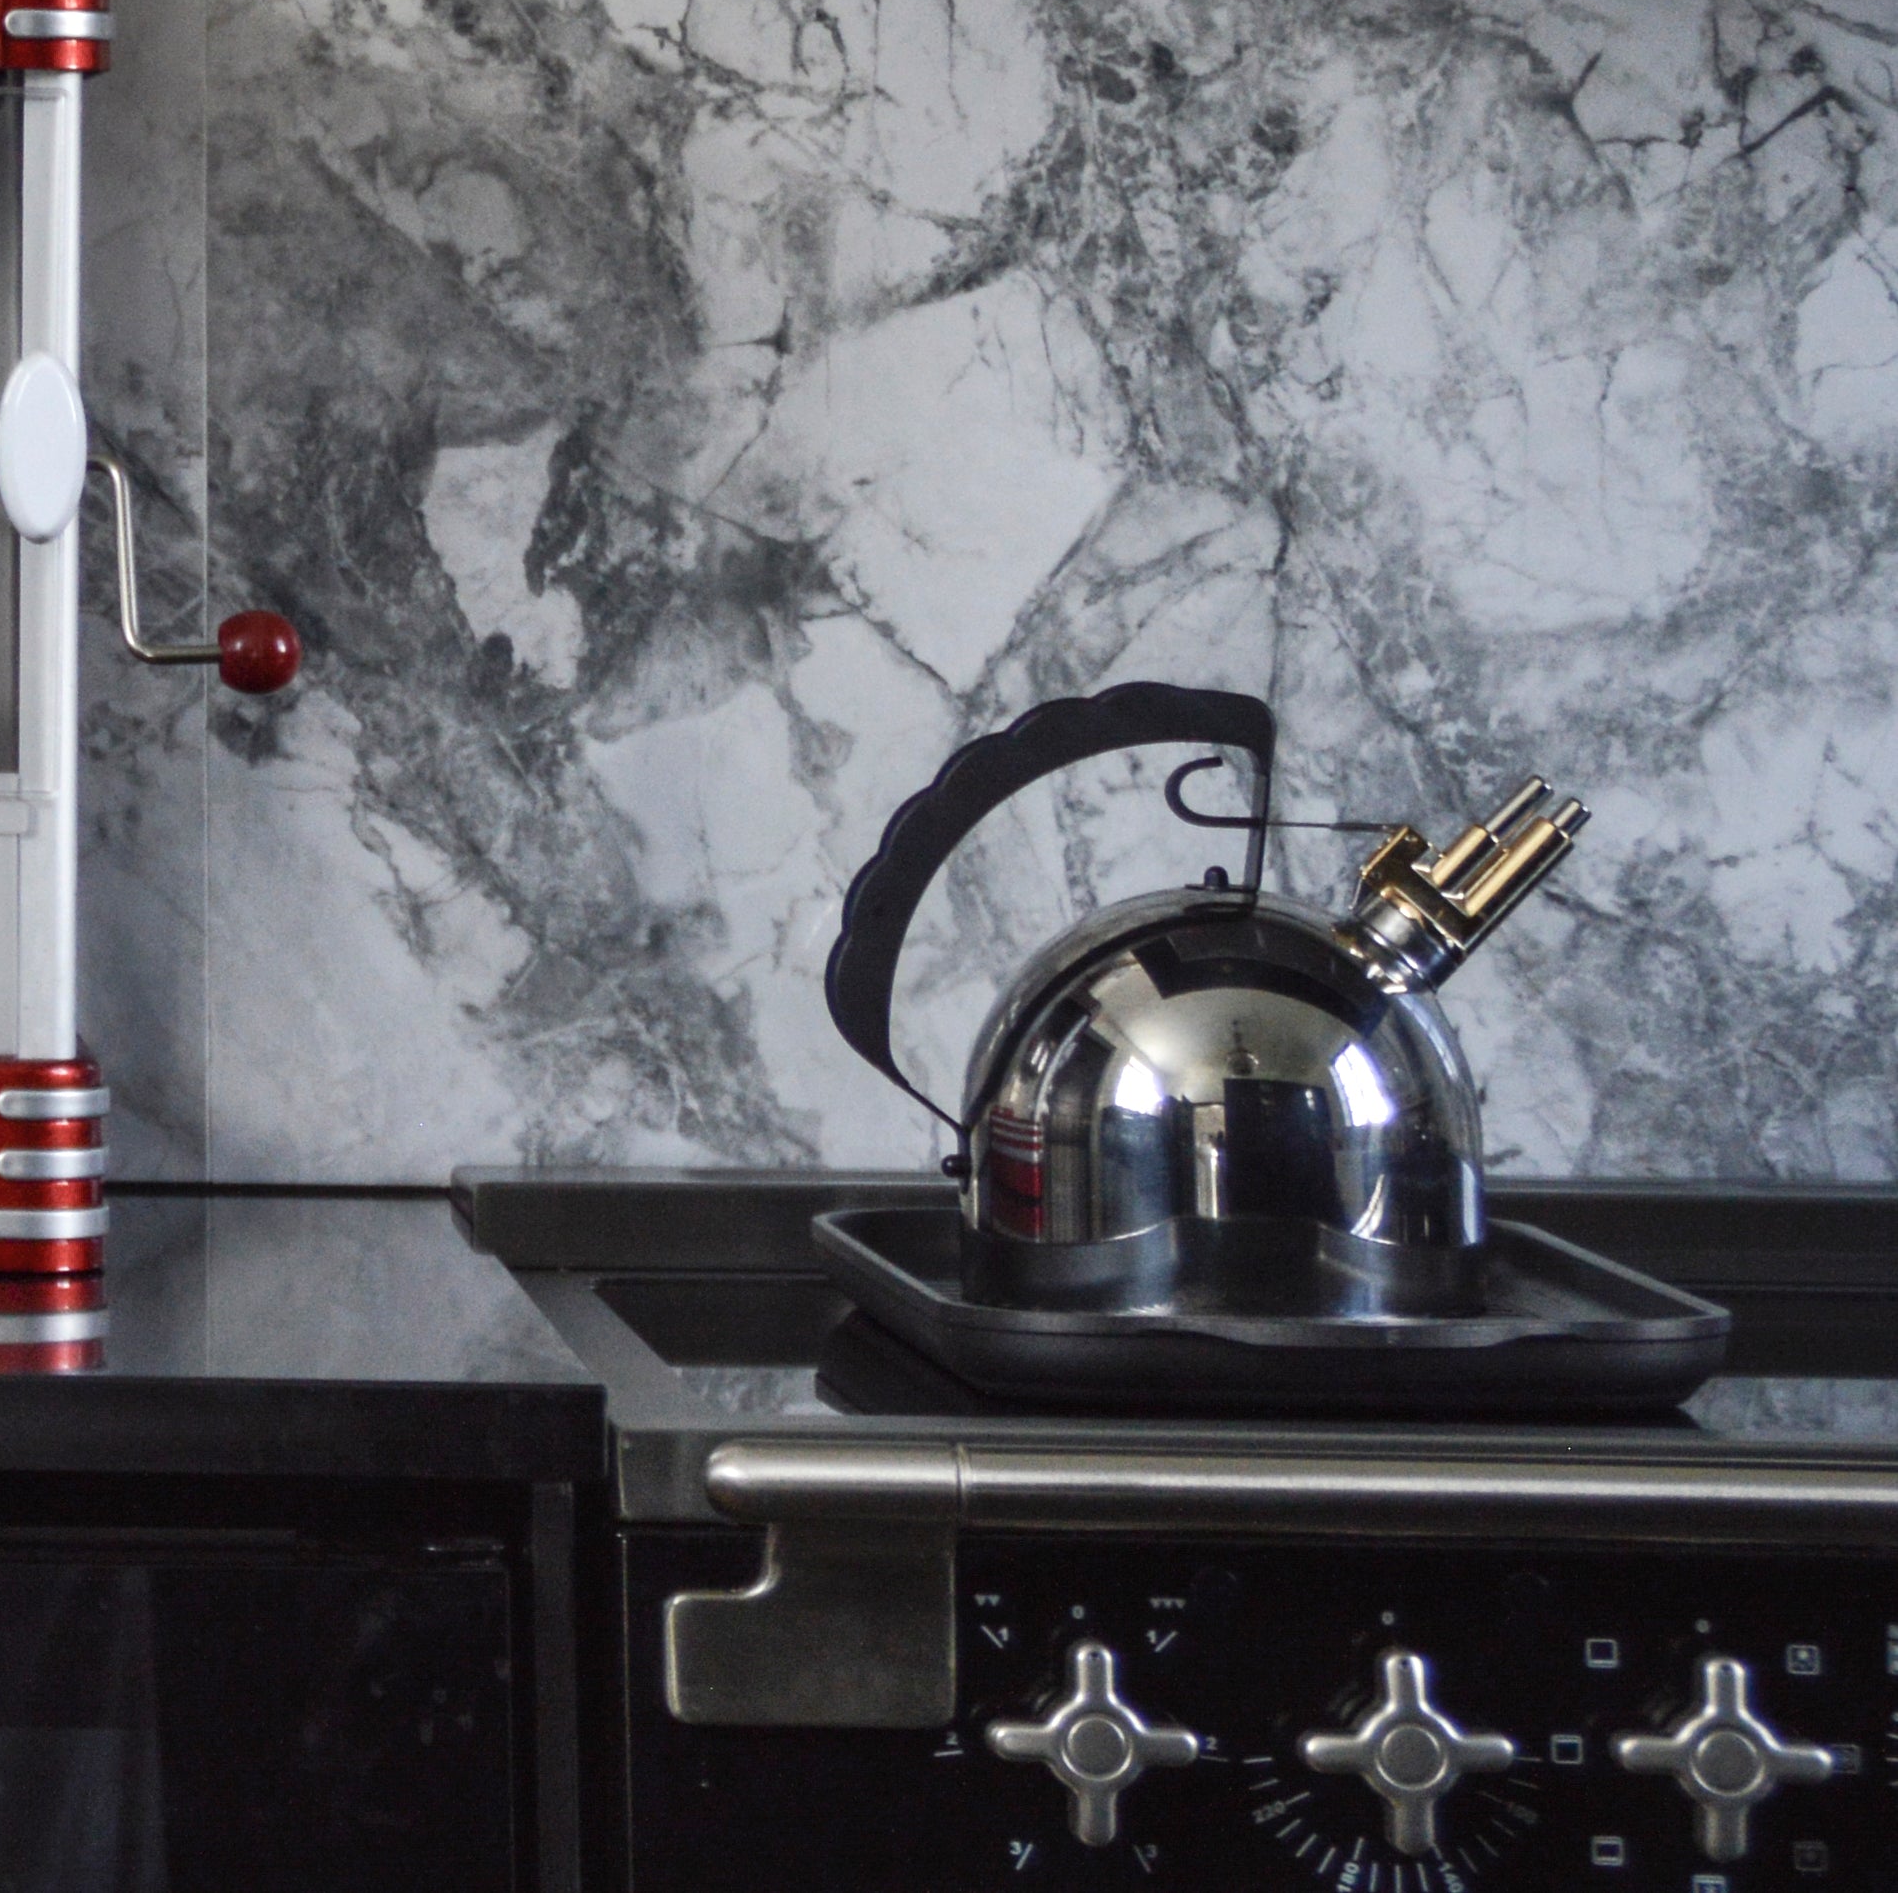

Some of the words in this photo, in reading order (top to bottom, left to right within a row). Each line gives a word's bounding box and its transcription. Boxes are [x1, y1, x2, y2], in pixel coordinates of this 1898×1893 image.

[1206, 1736, 1218, 1751] 2
[1009, 1841, 1023, 1856] 3
[1335, 1861, 1361, 1893] 180
